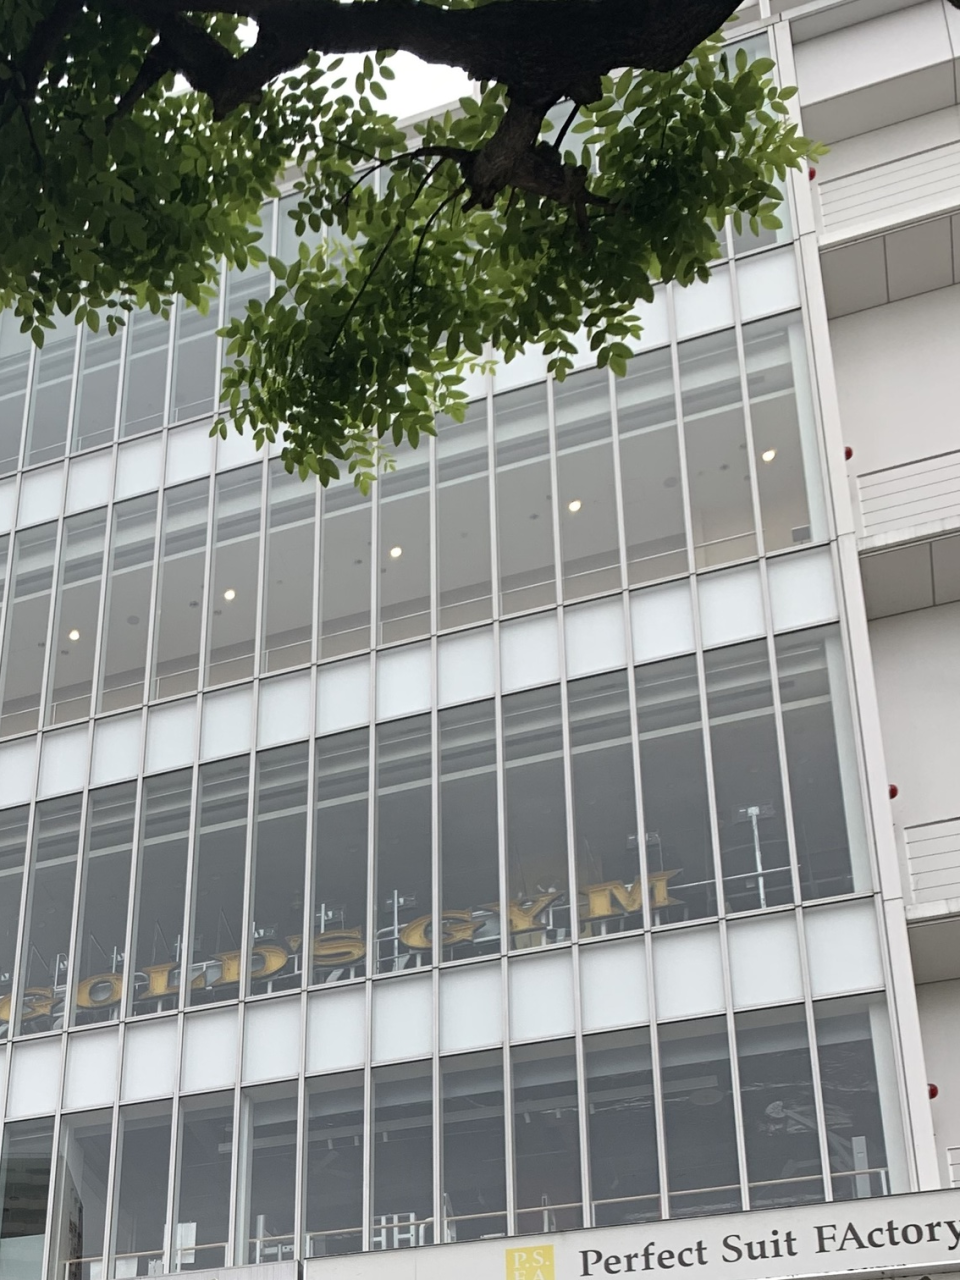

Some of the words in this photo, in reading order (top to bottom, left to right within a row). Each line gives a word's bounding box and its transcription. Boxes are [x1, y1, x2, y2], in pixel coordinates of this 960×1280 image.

[398, 868, 685, 949] GYM
[578, 1240, 708, 1277] Perfect
[722, 1229, 798, 1263] Suit
